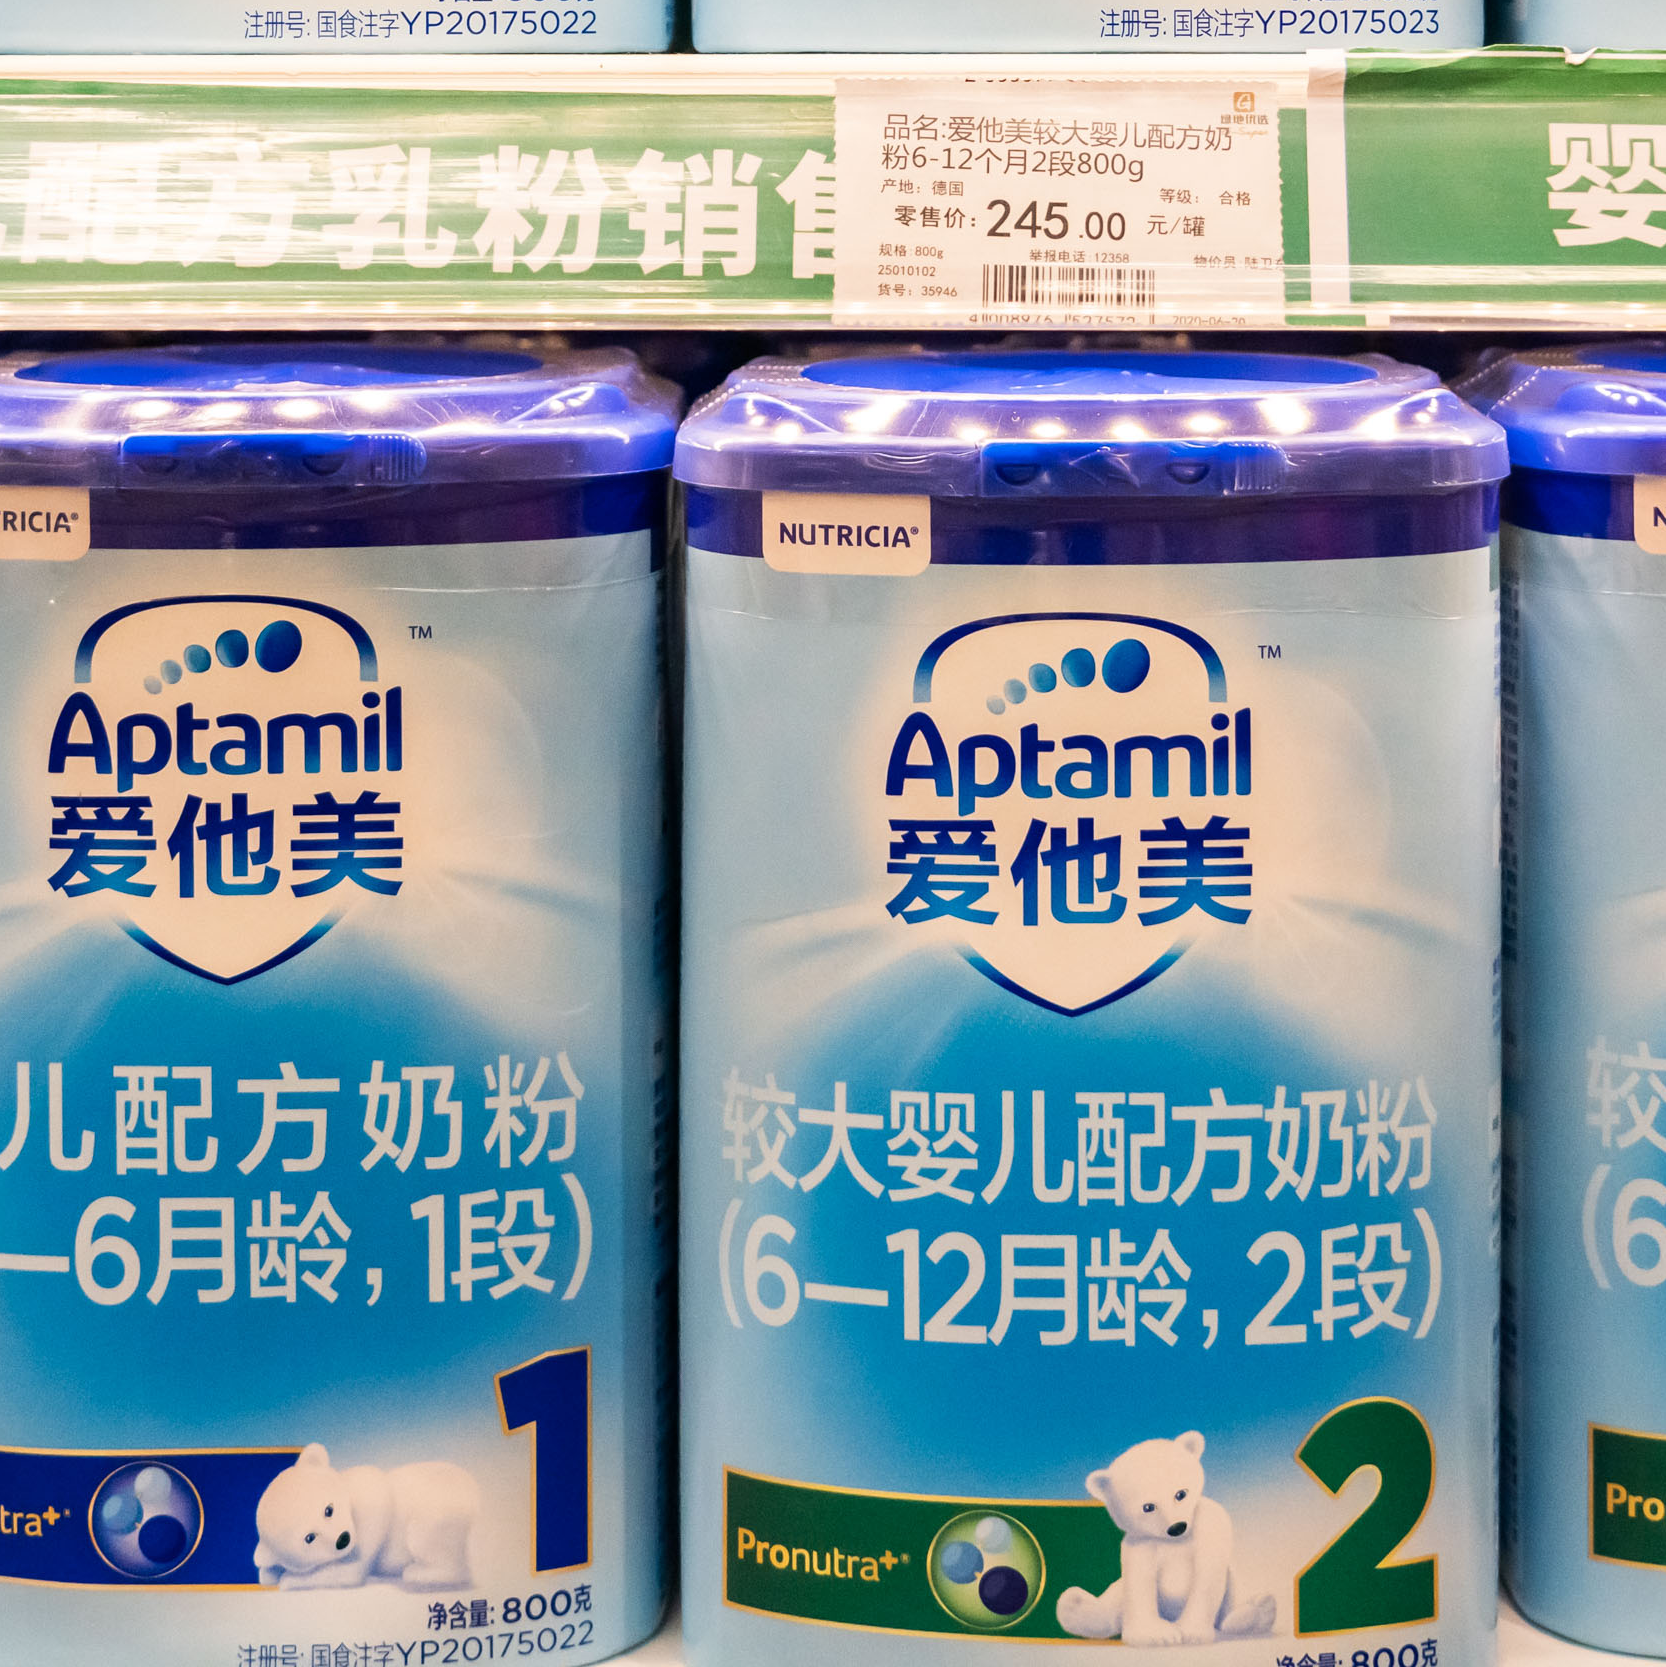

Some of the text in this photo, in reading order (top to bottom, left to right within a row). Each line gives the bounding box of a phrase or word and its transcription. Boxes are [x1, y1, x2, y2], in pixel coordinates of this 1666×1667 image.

[877, 264, 937, 278] 25010102
[920, 285, 959, 299] 35946
[1093, 251, 1131, 265] 12358
[47, 685, 403, 794] Aptamil
[884, 706, 1252, 818] Aptamil
[47, 790, 404, 899] 爱他美
[884, 814, 1253, 927] 爱他美
[722, 1067, 1438, 1208] 较大婴儿配方奶粉
[493, 1342, 593, 1575] 1
[1292, 1394, 1440, 1640] 2
